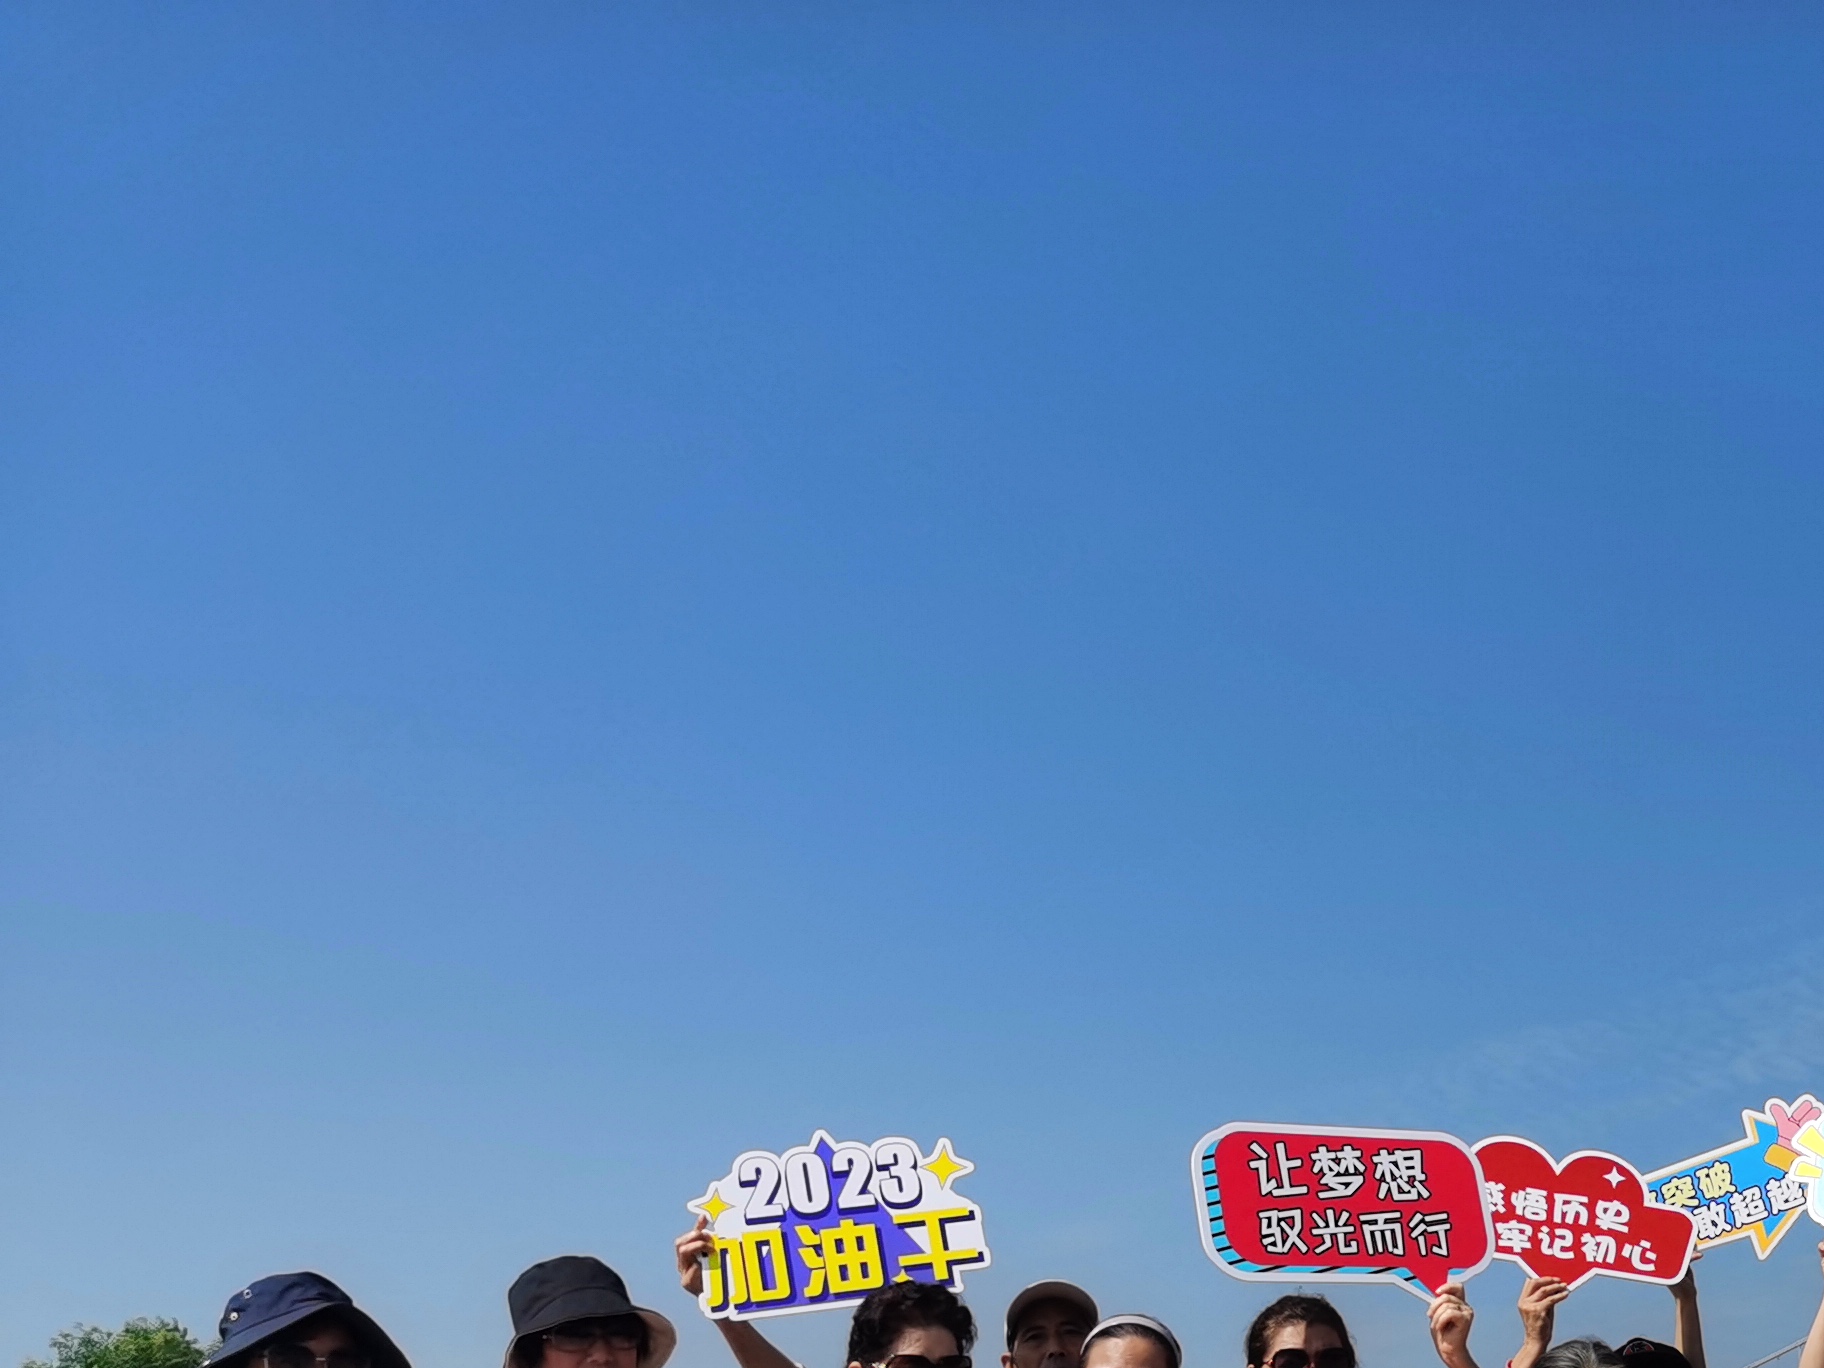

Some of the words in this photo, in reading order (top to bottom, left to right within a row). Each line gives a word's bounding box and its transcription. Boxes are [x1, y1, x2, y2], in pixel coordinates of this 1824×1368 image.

[738, 1142, 923, 1226] 2023
[1249, 1141, 1432, 1202] 让梦想
[1649, 1159, 1737, 1209] 突破
[703, 1206, 985, 1313] 加油干
[1258, 1208, 1452, 1258] 驭光而行
[1494, 1219, 1658, 1273] 牢记初心
